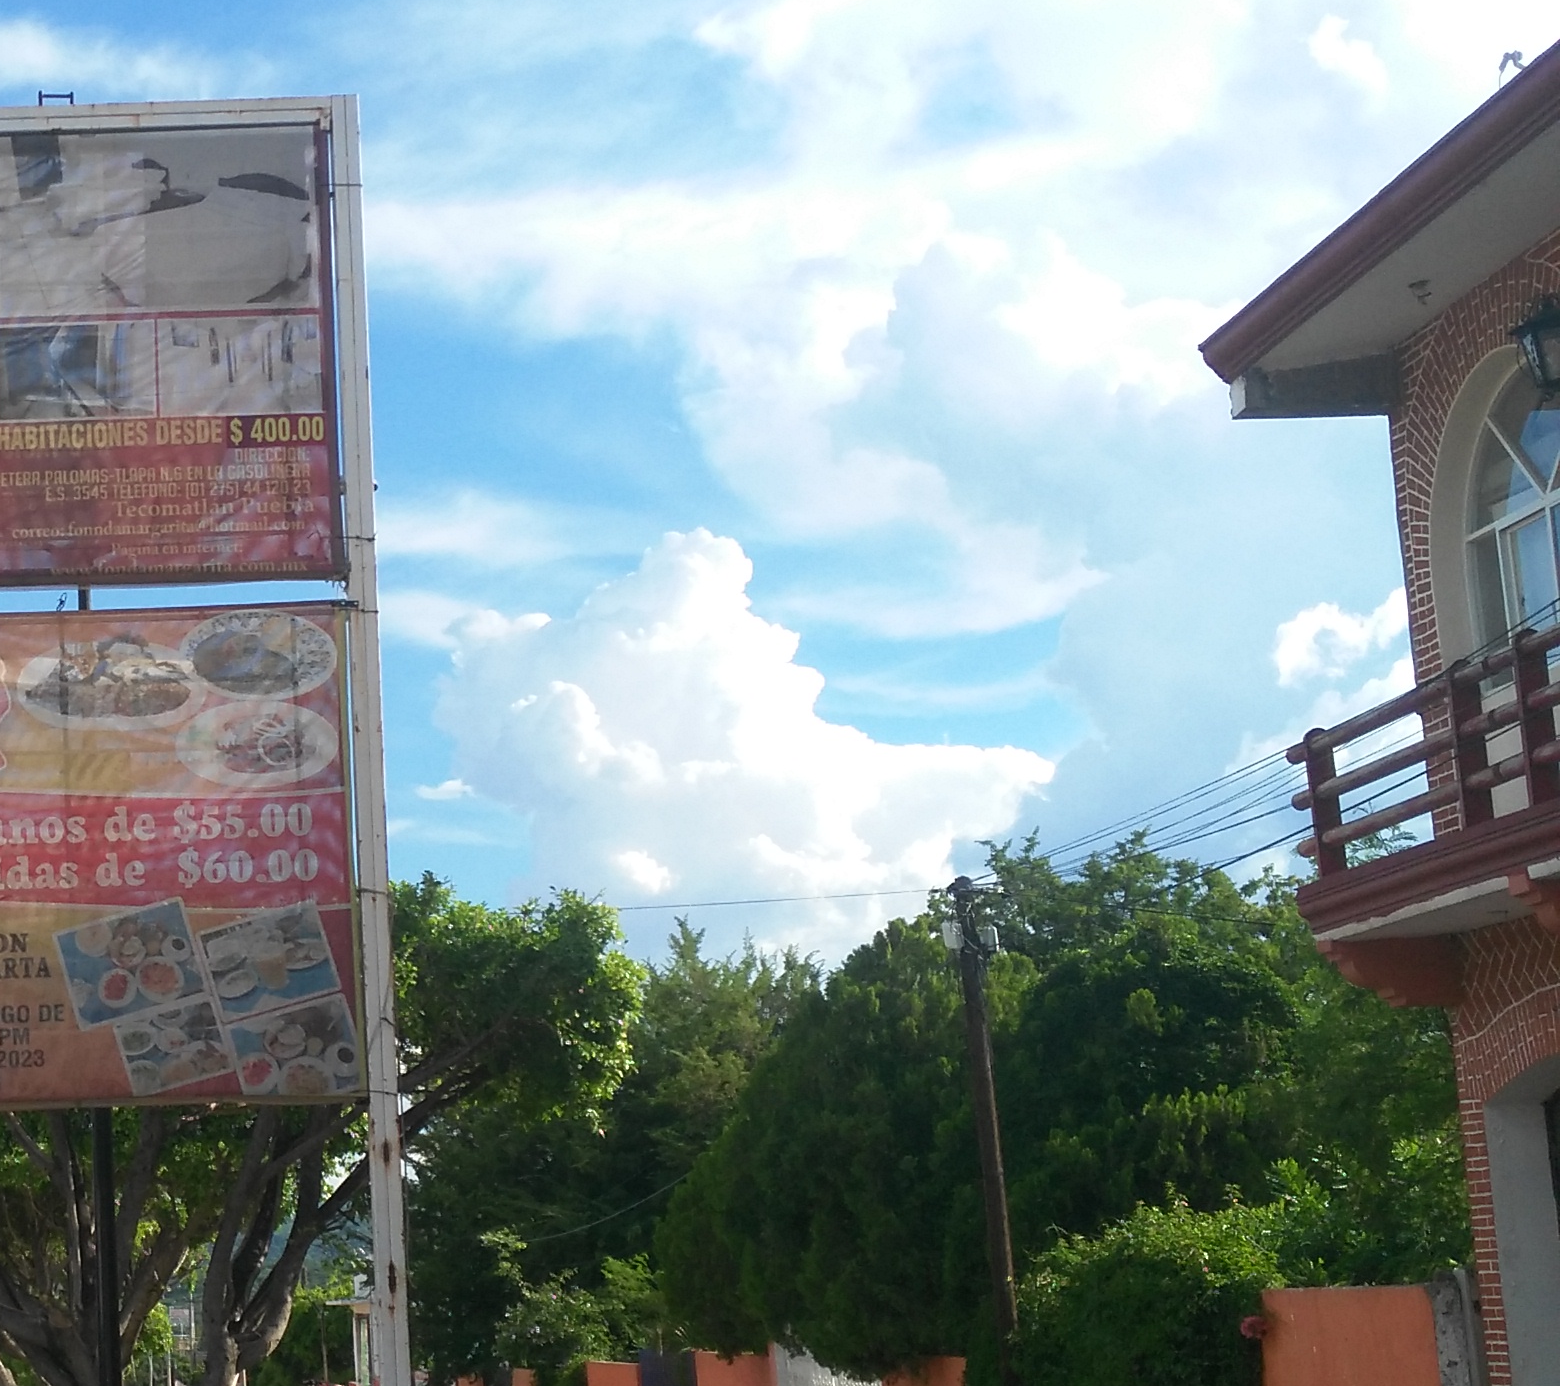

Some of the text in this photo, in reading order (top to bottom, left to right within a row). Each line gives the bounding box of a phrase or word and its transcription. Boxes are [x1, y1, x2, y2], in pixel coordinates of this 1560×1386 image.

[155, 418, 223, 445] DESDE
[229, 417, 243, 446] $
[250, 416, 325, 443] 400.00
[44, 466, 156, 486] PALOMAS-TLAPA
[187, 465, 204, 481] EN
[207, 464, 223, 480] LA
[227, 462, 311, 480] GASOLINERA
[45, 486, 68, 502] E.S.
[73, 485, 108, 500] 3545
[113, 482, 182, 499] TELEFONO:
[243, 481, 260, 494] 44
[265, 480, 289, 495] 120
[294, 479, 311, 494] 23
[241, 496, 314, 514] Puebla
[162, 544, 180, 555] en
[104, 806, 156, 842] de
[174, 801, 312, 843] $55.00
[95, 852, 146, 887] de
[178, 846, 319, 888] $60.00
[39, 1003, 65, 1023] DE
